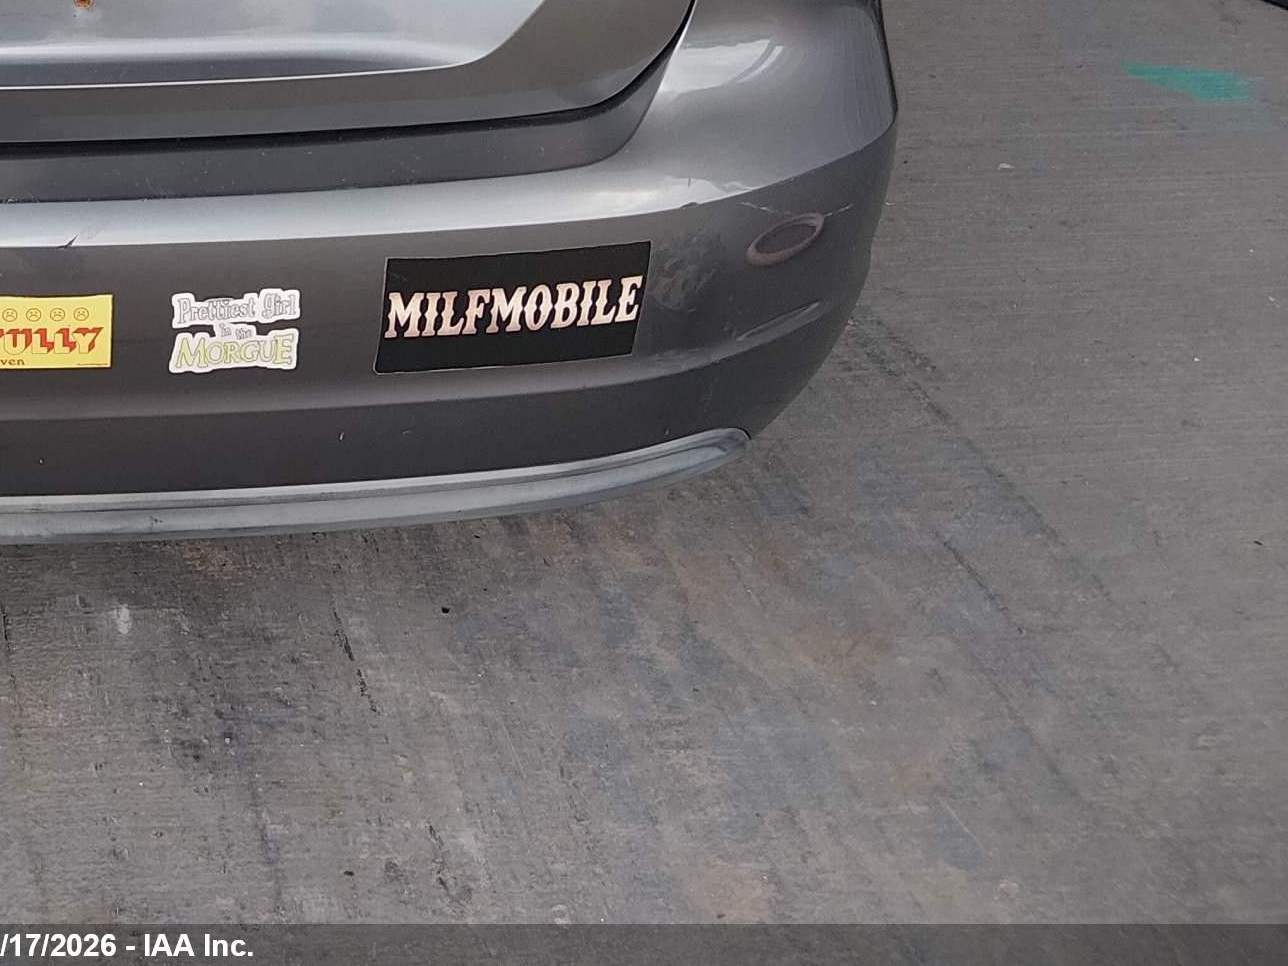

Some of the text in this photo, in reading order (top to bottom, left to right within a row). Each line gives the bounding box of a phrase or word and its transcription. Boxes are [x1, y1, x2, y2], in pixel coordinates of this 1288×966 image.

[177, 297, 256, 324] Prettiest
[383, 275, 644, 339] MILFMOBILE
[175, 333, 295, 369] MORGUE
